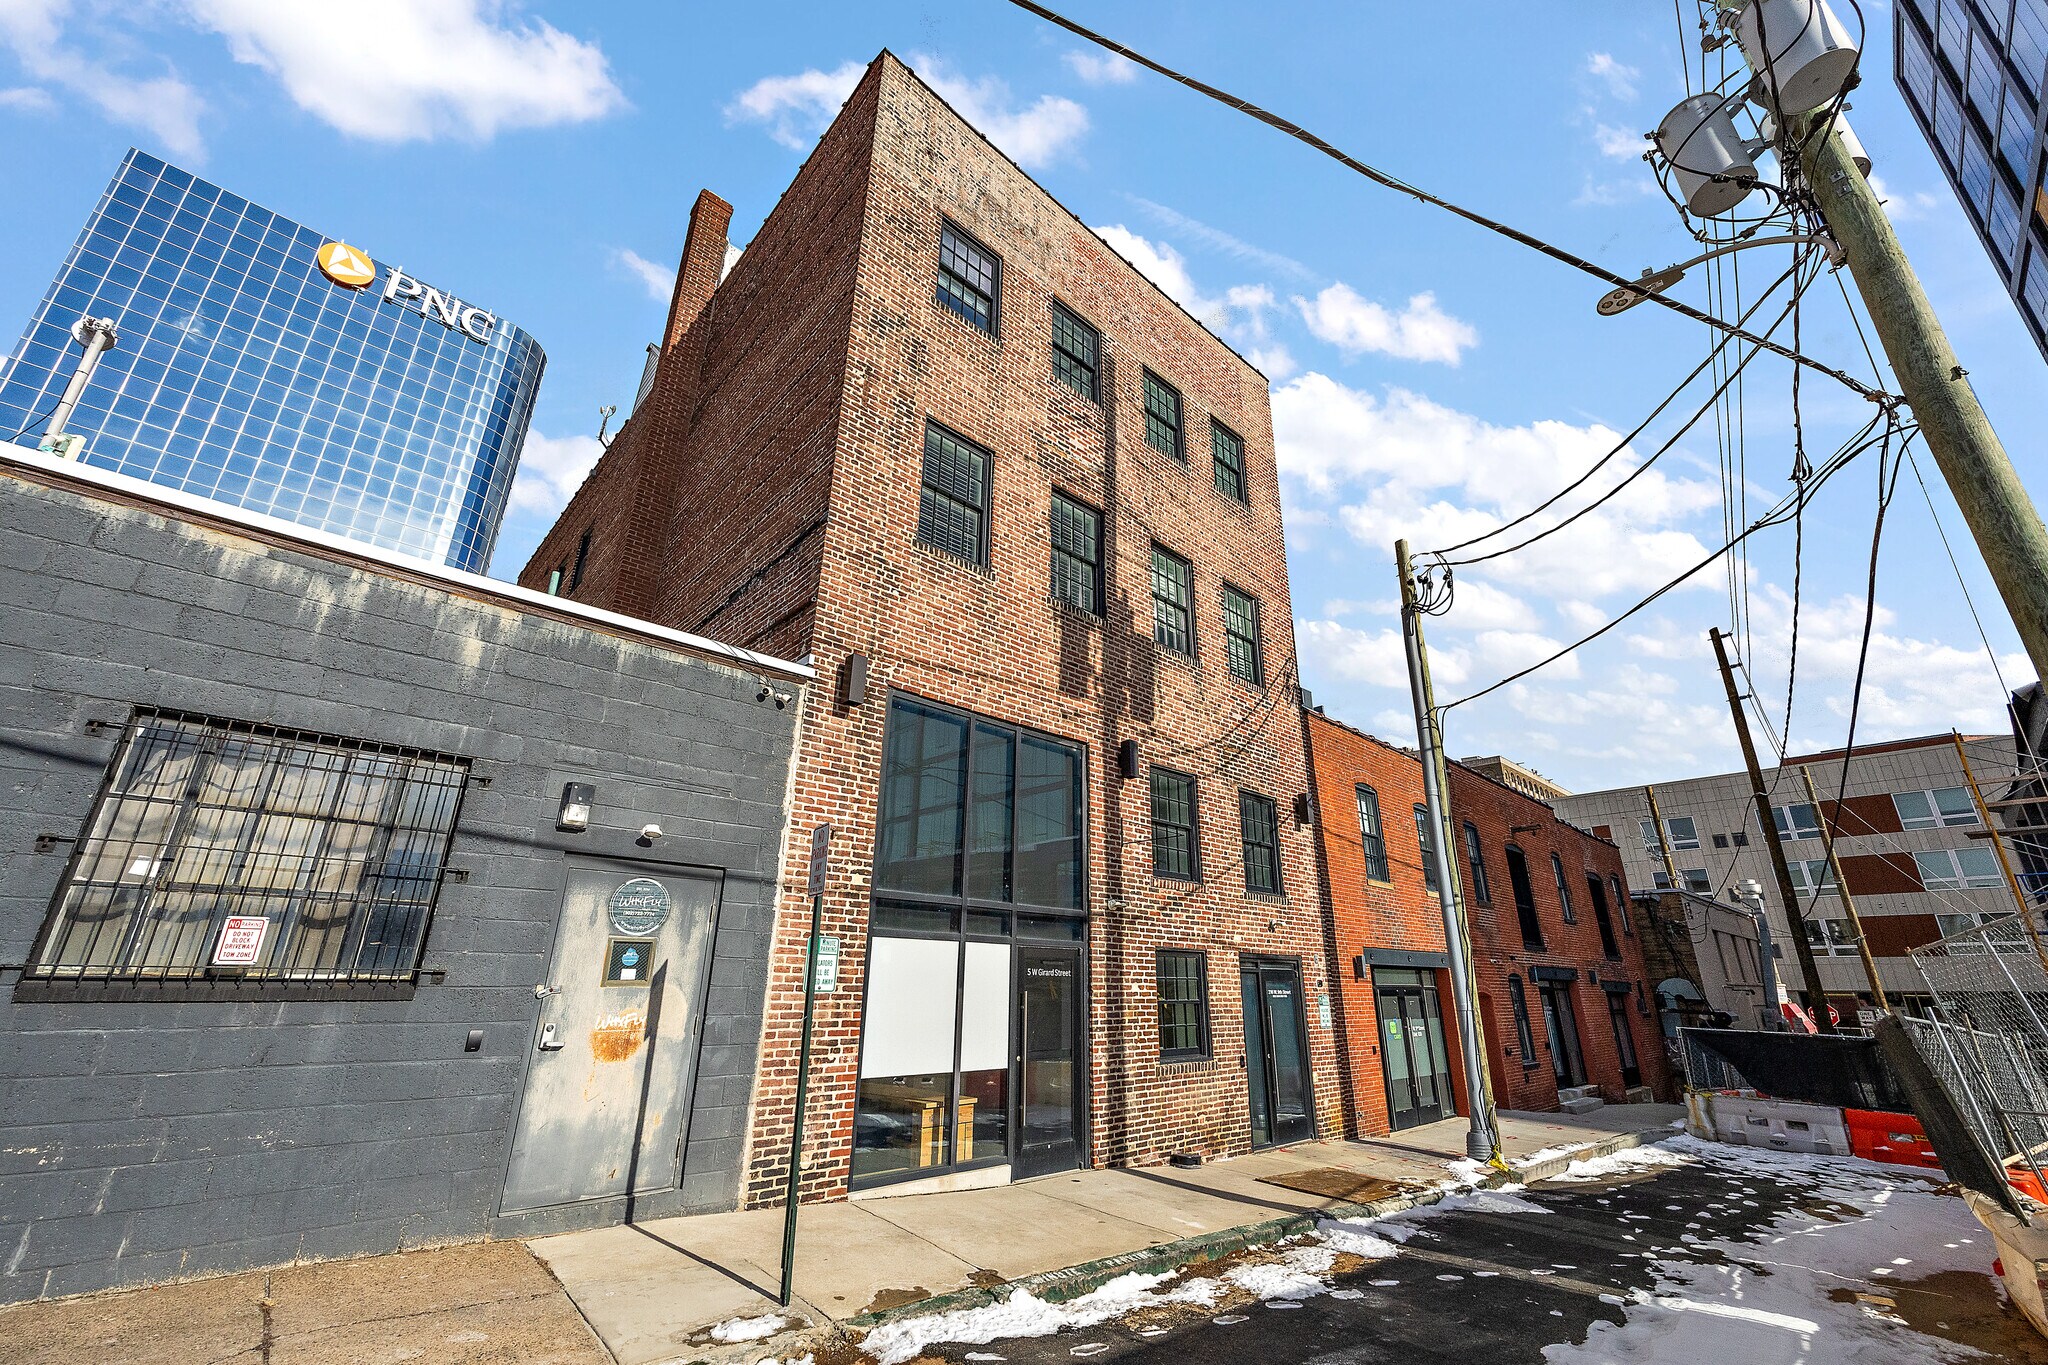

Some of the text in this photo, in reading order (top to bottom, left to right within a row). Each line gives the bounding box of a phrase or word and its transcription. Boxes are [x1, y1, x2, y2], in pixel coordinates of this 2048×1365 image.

[386, 266, 496, 342] PNC
[229, 920, 241, 928] NO
[1032, 968, 1038, 976] W
[1038, 968, 1055, 976] Girard
[1055, 968, 1071, 977] Street
[1810, 1010, 1837, 1020] SP
